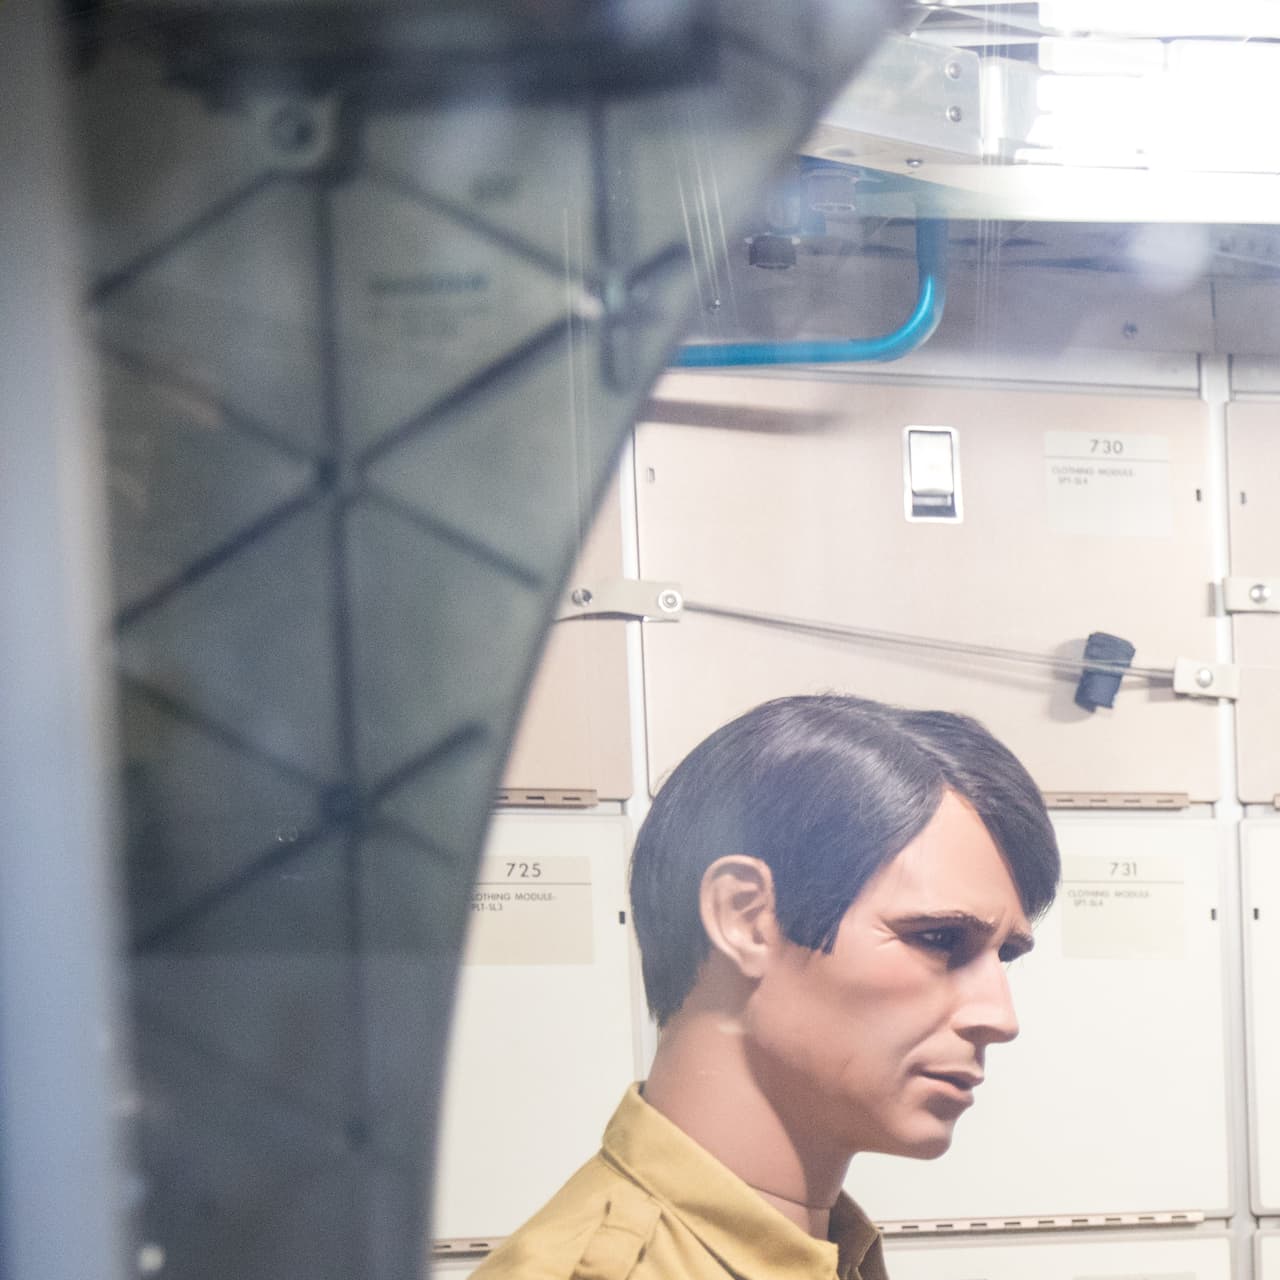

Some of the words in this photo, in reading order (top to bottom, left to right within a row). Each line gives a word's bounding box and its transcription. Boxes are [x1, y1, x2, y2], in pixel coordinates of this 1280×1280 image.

[1090, 438, 1124, 455] 730
[504, 862, 542, 878] 725
[1110, 861, 1137, 877] 731
[471, 892, 512, 902] LOTHING
